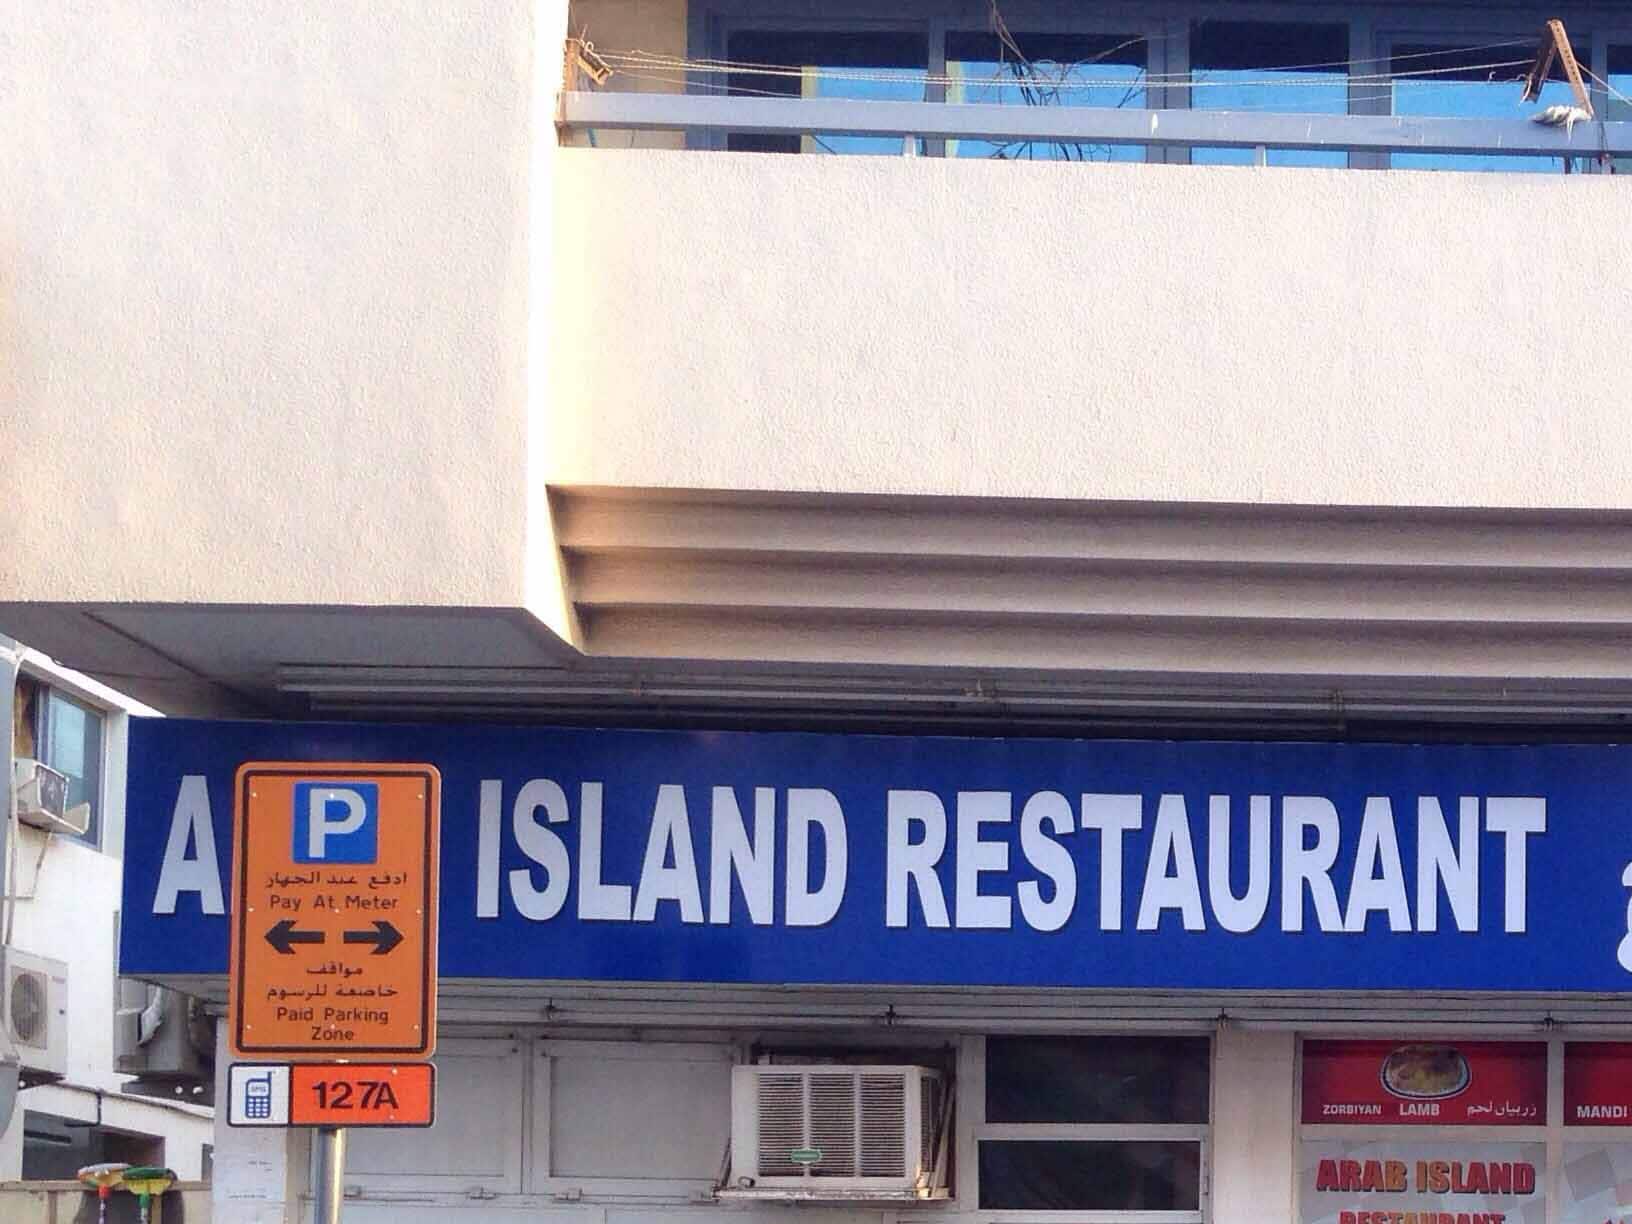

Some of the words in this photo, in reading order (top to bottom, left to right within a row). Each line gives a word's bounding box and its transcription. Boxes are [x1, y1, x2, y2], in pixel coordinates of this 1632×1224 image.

[308, 788, 367, 858] P
[476, 778, 848, 927] ISLAND
[885, 789, 1547, 933] RESTAURANT
[269, 894, 301, 911] Pay
[312, 894, 335, 910] At
[344, 895, 399, 910] Meter
[276, 1007, 314, 1022] Paid
[323, 1007, 389, 1024] Parking
[311, 1026, 355, 1041] Zone
[312, 1081, 400, 1109] 127A
[1322, 1104, 1382, 1116] ZORBIYAN
[1399, 1103, 1441, 1117] LAMB
[1576, 1105, 1628, 1119] MANDI
[1315, 1159, 1408, 1192] ARAB
[1415, 1160, 1536, 1195] ISLAND
